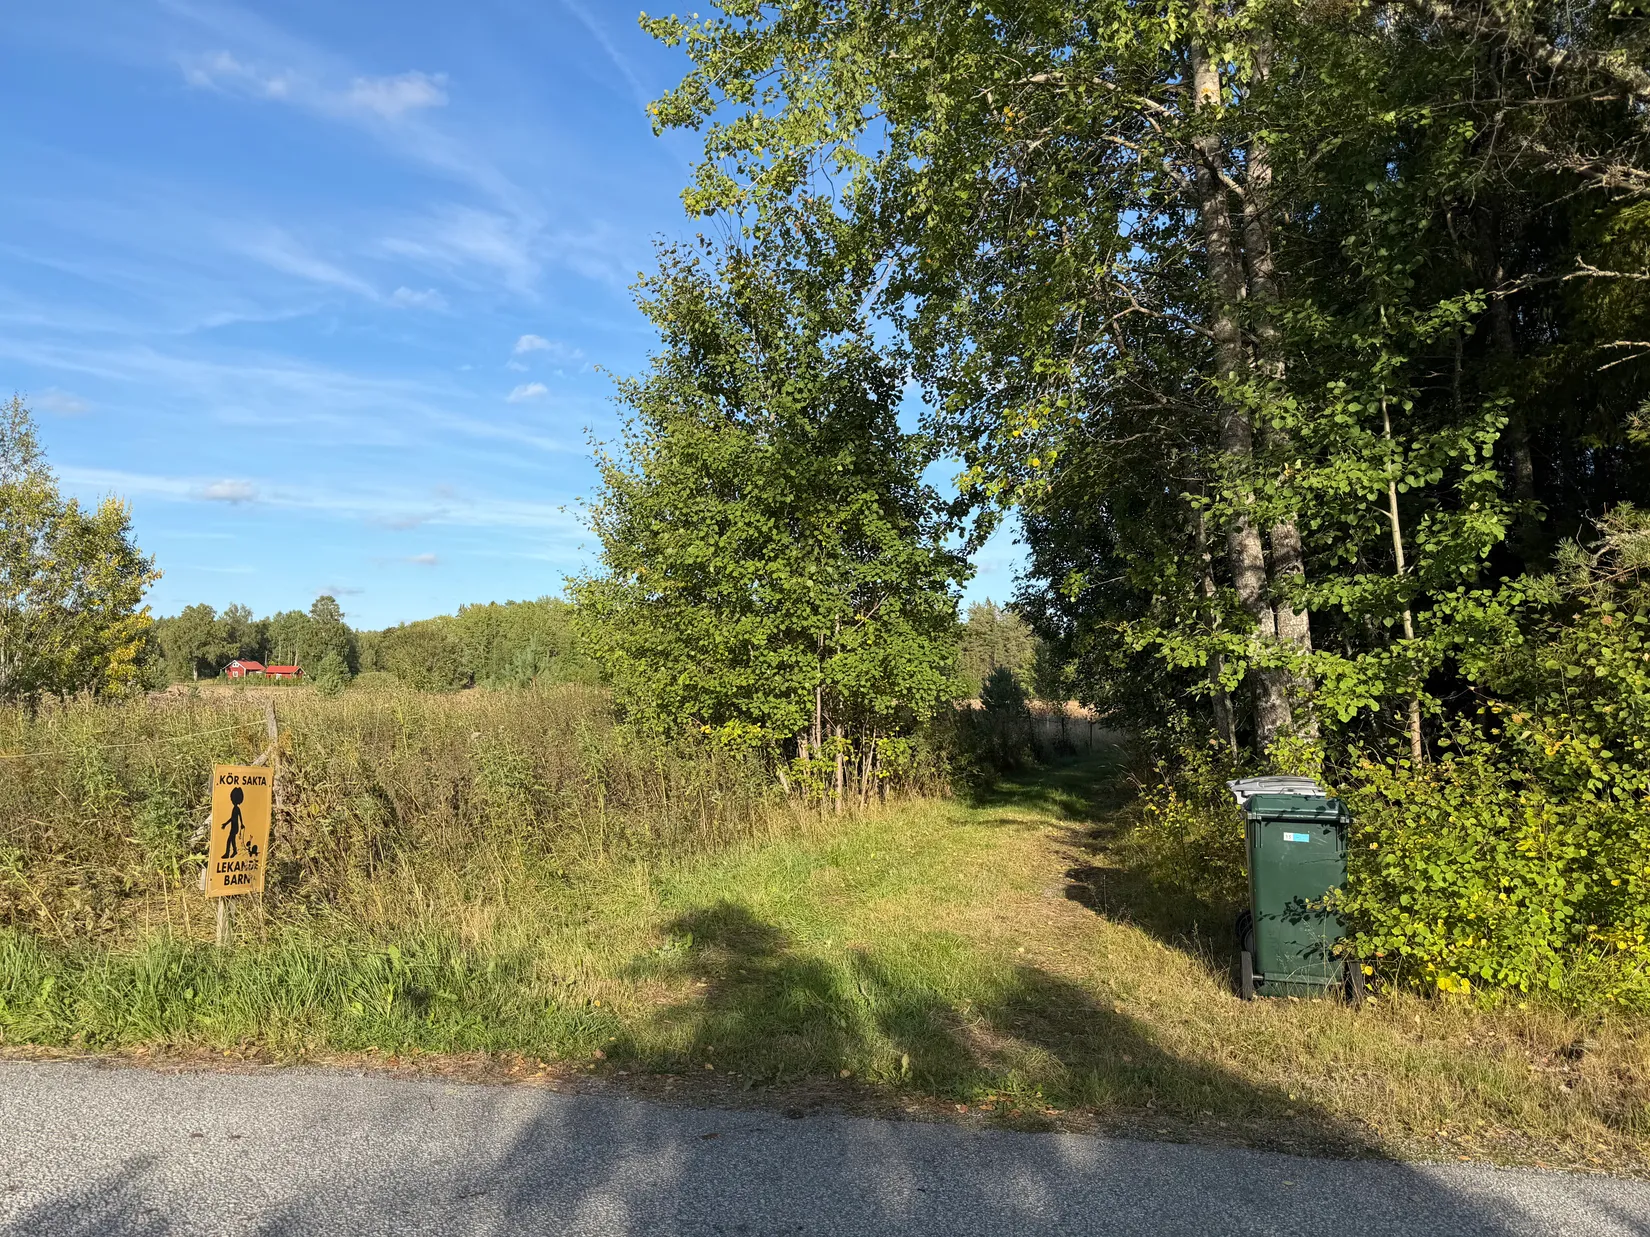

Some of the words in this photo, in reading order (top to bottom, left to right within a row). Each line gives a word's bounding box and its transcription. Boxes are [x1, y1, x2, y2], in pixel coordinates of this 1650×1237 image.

[219, 773, 239, 785] KÖR
[242, 775, 267, 786] SAKTA
[223, 873, 251, 886] BARN
